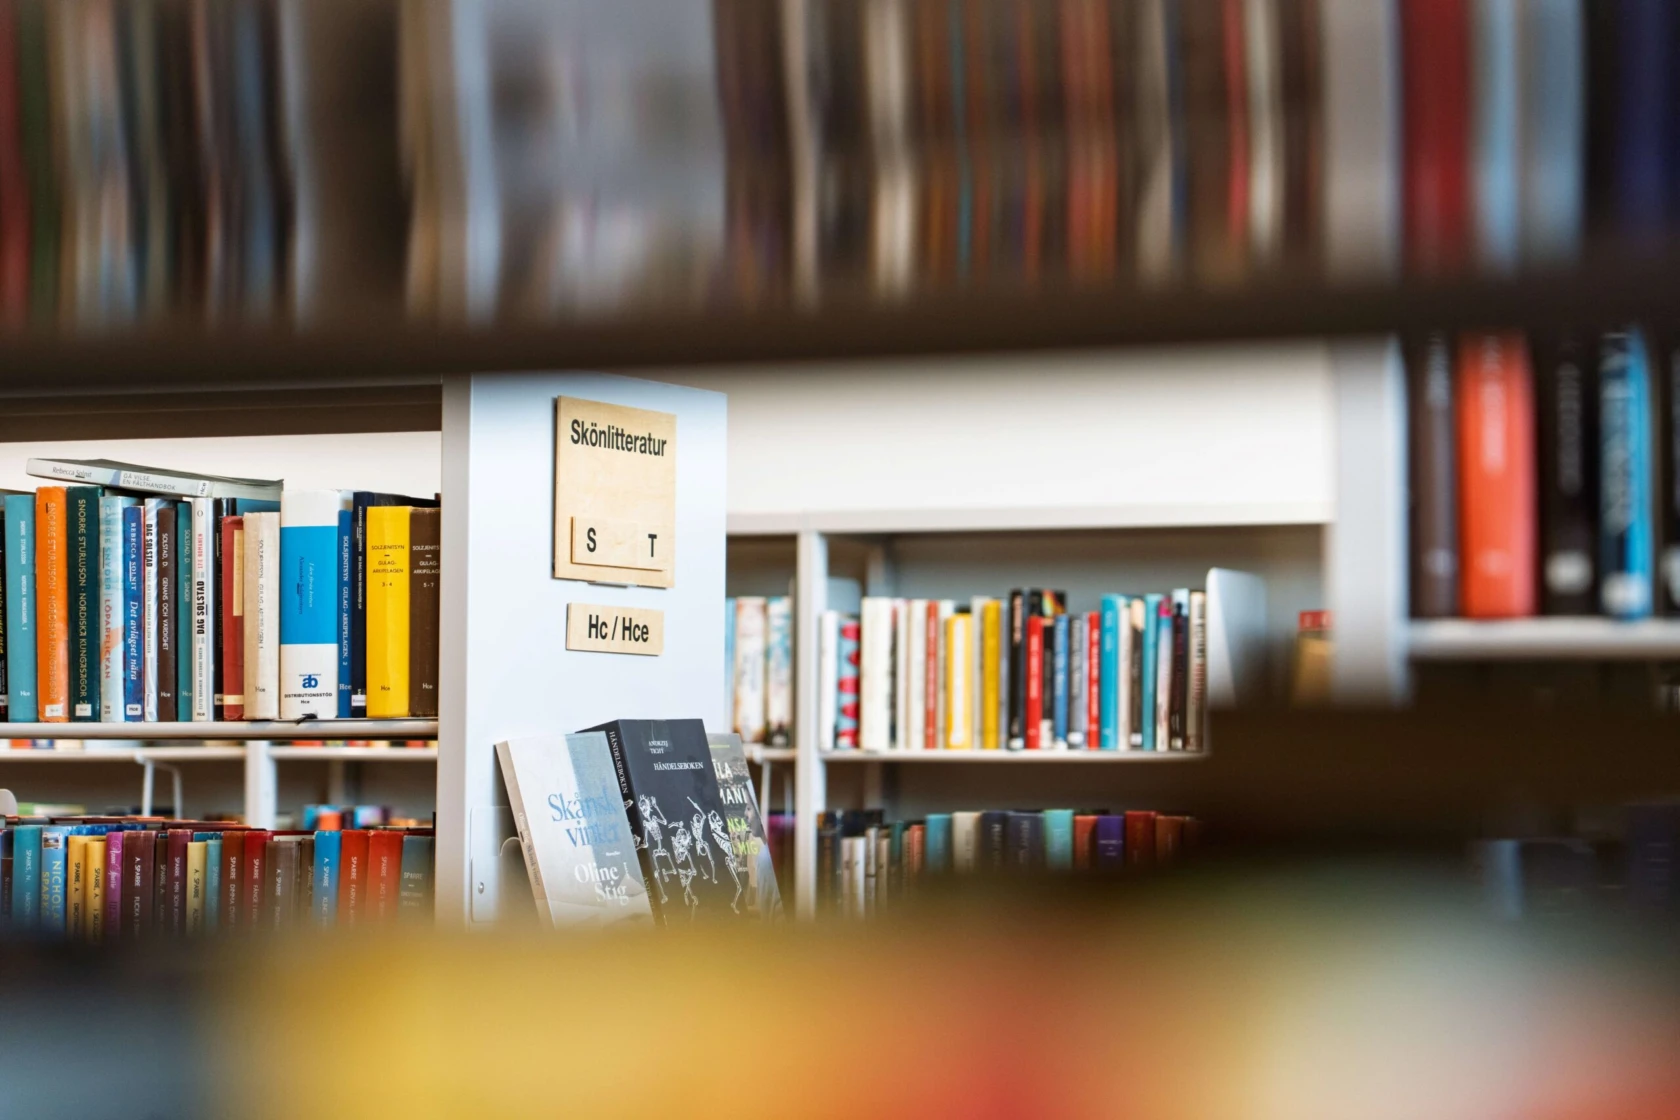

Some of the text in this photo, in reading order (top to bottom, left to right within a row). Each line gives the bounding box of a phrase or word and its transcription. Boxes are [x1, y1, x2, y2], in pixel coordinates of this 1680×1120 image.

[570, 419, 667, 457] Skönlitteratur
[52, 466, 75, 476] Rebecca
[48, 503, 56, 536] SNORRE
[146, 539, 154, 567] SOLSTAD
[586, 527, 657, 558] S T
[103, 547, 111, 590] SNYDER
[129, 561, 137, 591] SOLNIT
[79, 593, 87, 636] NORDISKA
[196, 581, 205, 635] DAG SOLSTAD
[104, 599, 113, 679] LÖPARFLICKAN
[128, 601, 139, 680] Det avlägset nära
[588, 614, 649, 643] Hc / Hce
[609, 731, 628, 794] HÄNDELSEBOKEN
[653, 762, 704, 771] HÄNDELSEBOKEN
[548, 786, 617, 822] Skånsk
[565, 820, 620, 848] vinter
[525, 844, 535, 867] Skånsk
[574, 863, 620, 883] Oline
[51, 861, 61, 919] NICHOLA
[595, 881, 629, 906] Stig
